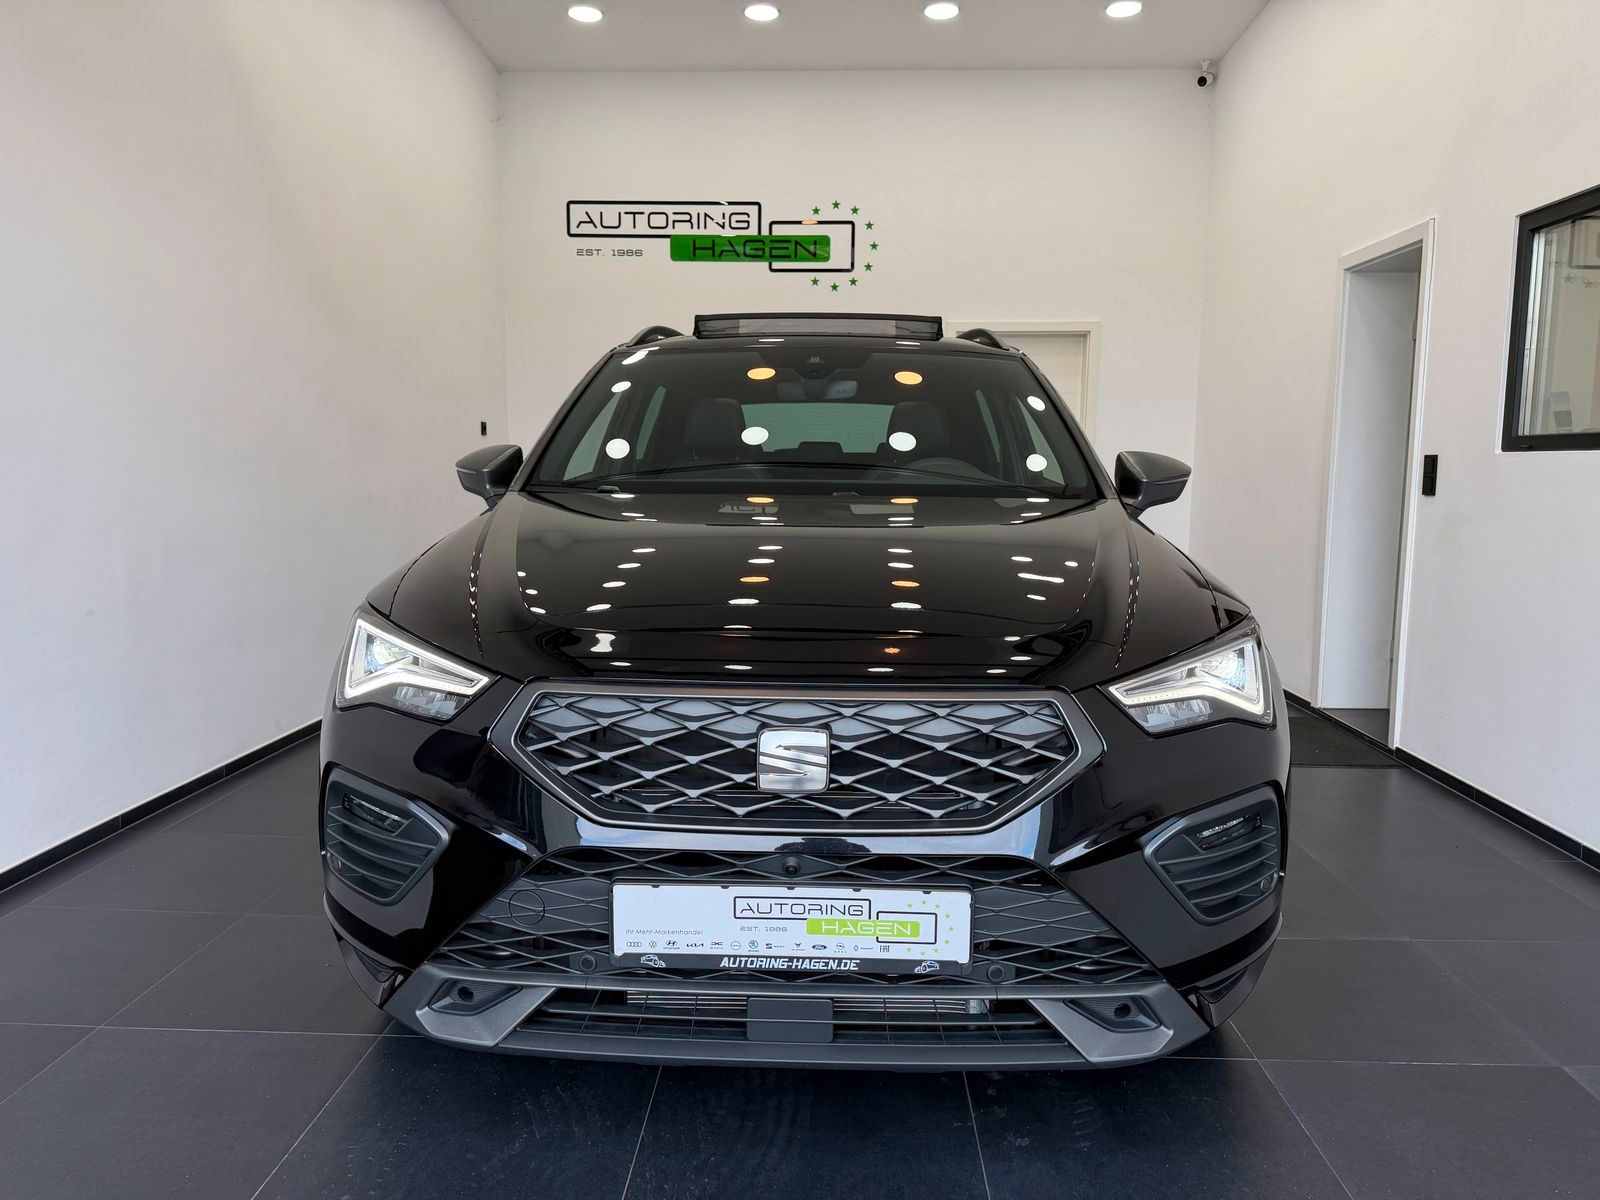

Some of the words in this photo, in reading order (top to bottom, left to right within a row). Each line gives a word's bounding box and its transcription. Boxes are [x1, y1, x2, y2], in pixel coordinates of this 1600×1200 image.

[576, 211, 751, 230] AUTORING
[576, 248, 605, 257] EST.
[611, 248, 644, 257] 1986
[692, 239, 818, 259] HAGEN
[740, 902, 864, 917] AUTORING
[821, 920, 912, 936] HAGEN
[720, 956, 860, 971] AUTORING-HAGEN.DE
